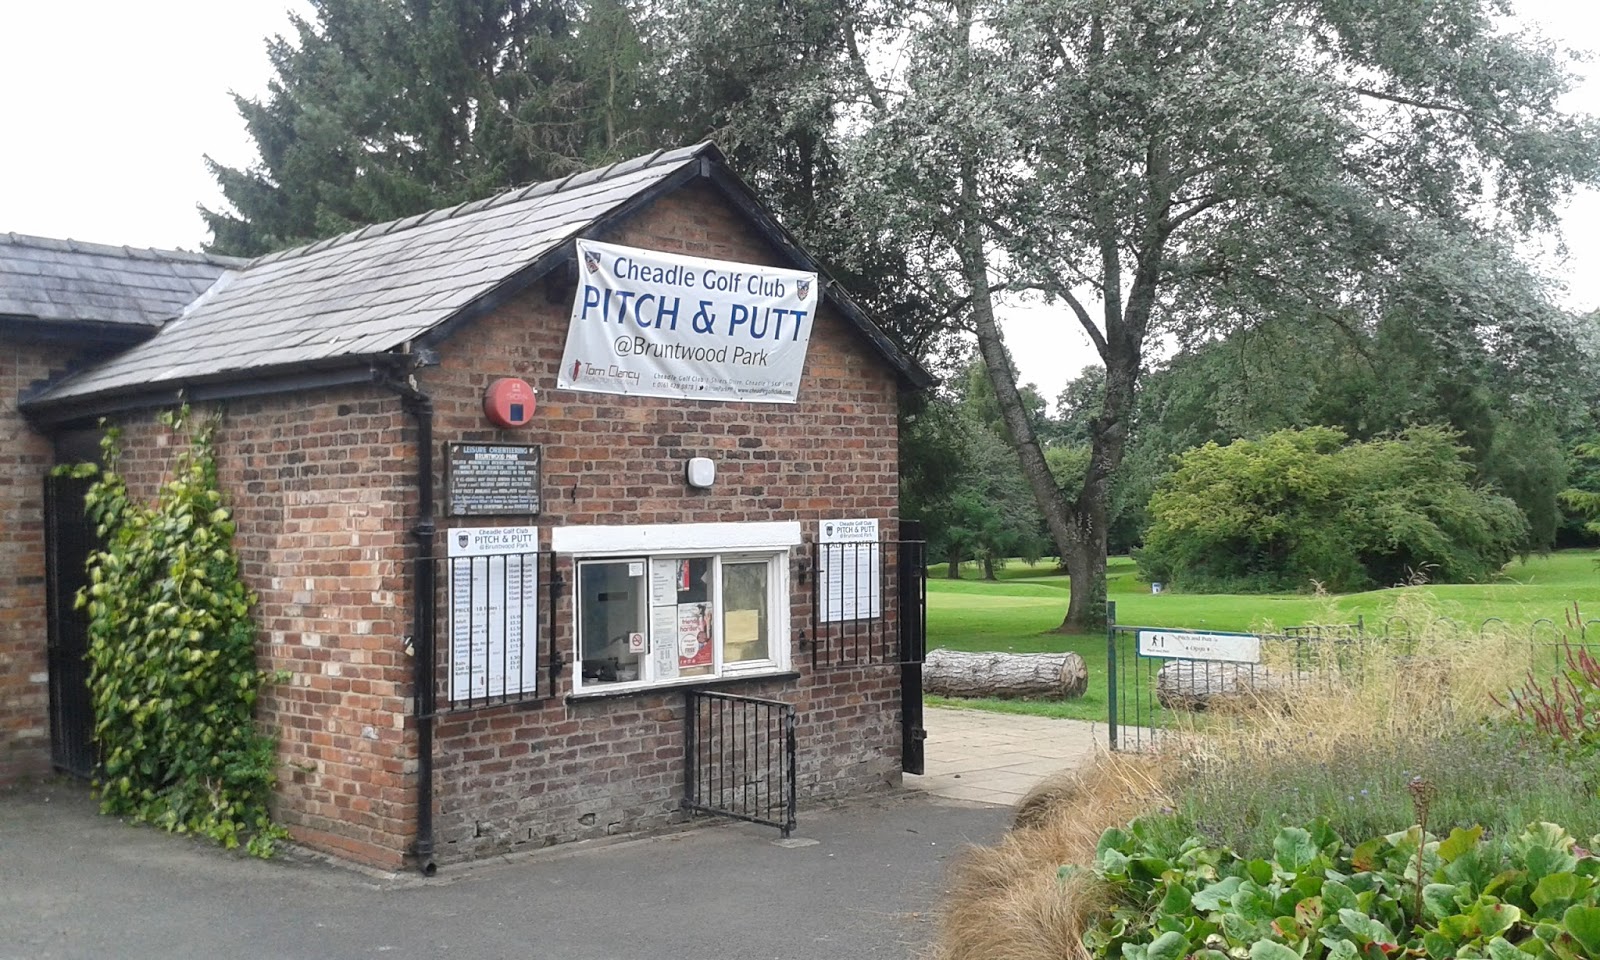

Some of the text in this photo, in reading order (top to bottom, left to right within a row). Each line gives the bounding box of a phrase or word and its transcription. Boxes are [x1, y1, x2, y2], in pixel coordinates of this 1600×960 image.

[614, 256, 785, 298] Cheadle Golf Club
[581, 285, 808, 342] PITCH & PUTT
[614, 335, 768, 366] @Bruntwood Park
[585, 362, 606, 376] Tom
[608, 364, 640, 386] Clancy
[463, 446, 487, 454] LEISURE
[475, 534, 533, 544] PITCH & PUTT
[837, 526, 853, 534] PITCH
[861, 525, 875, 533] PUTT
